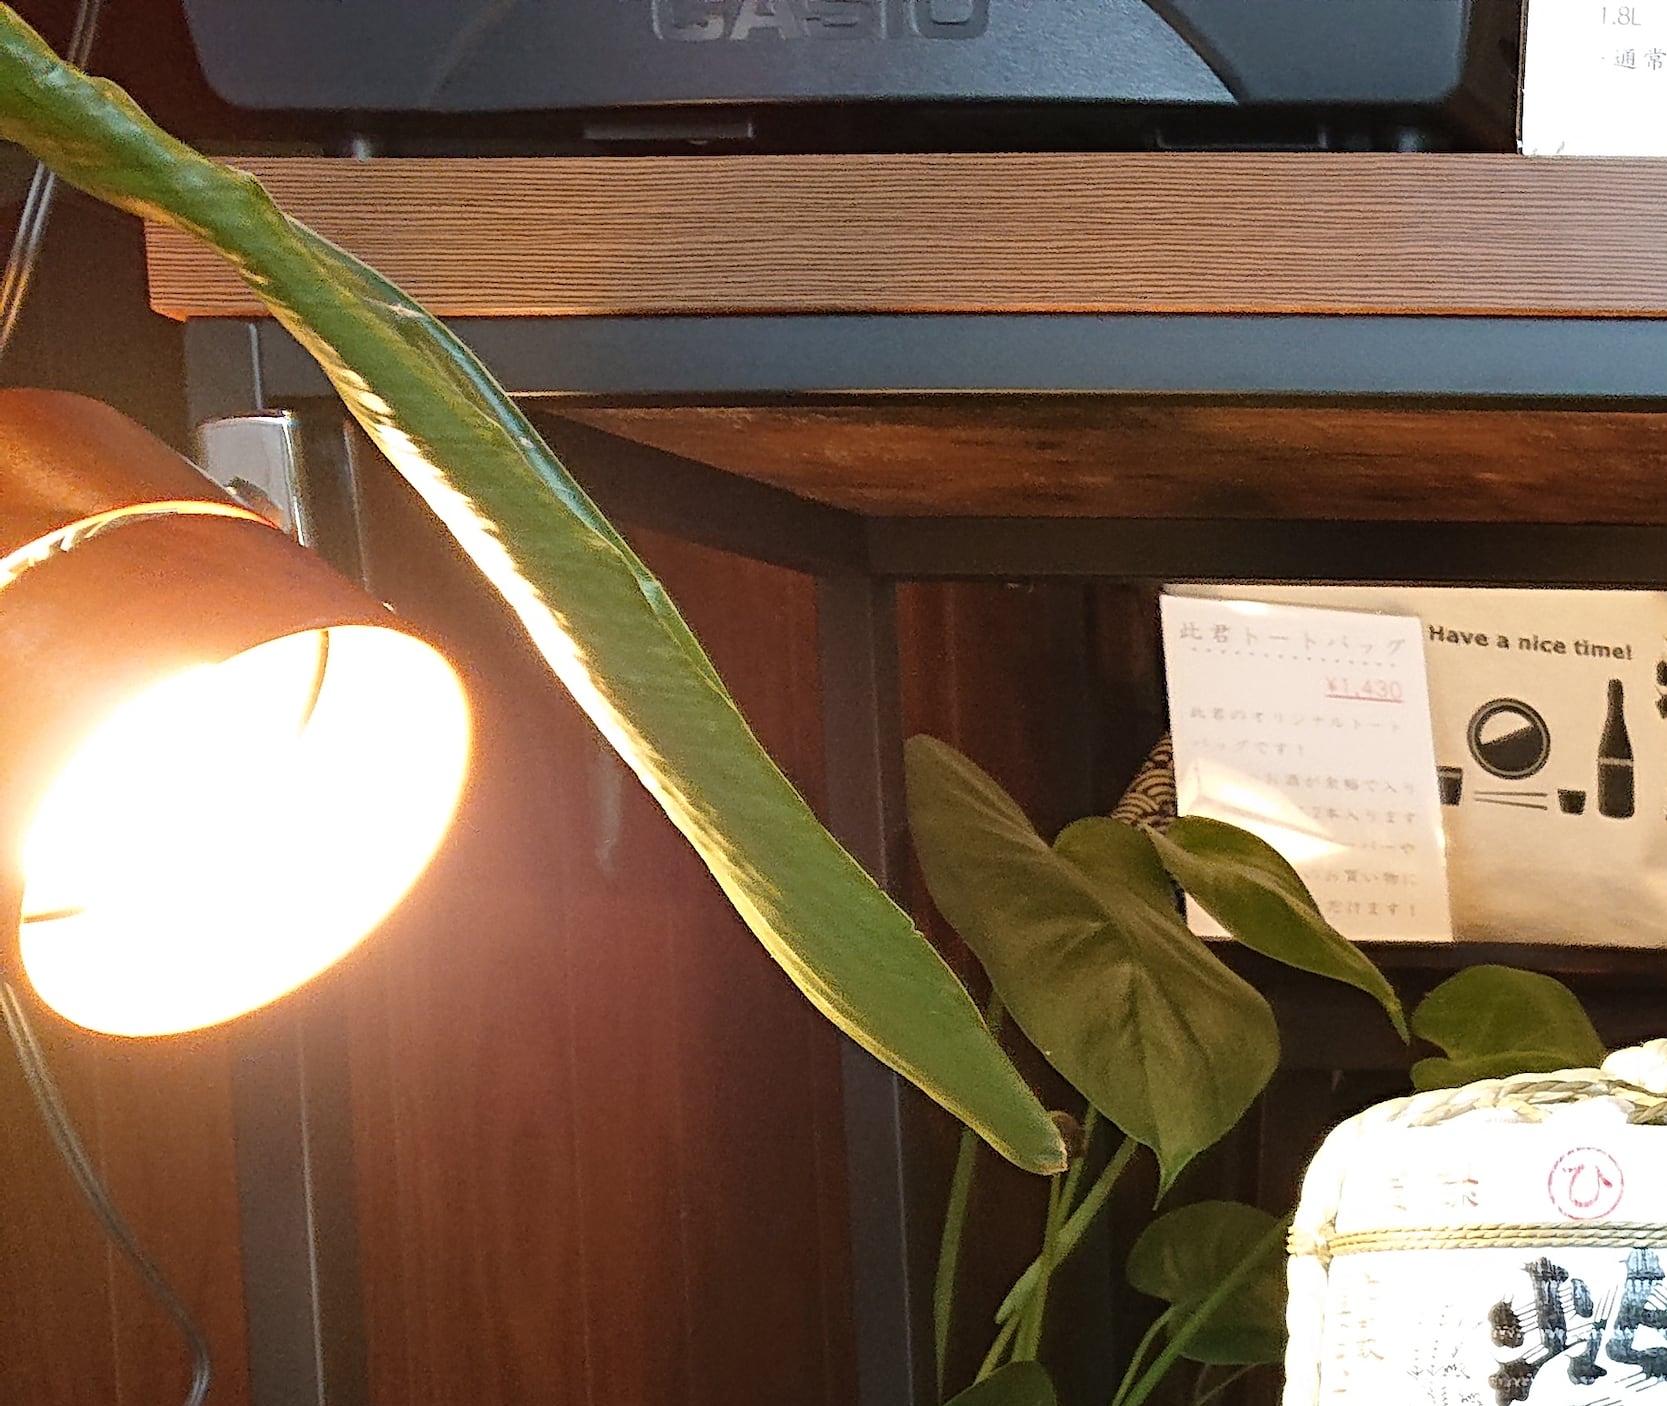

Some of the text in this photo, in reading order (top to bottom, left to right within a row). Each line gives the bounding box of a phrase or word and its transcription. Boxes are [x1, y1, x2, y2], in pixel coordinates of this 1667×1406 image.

[1602, 6, 1642, 25] 1.8L
[1428, 624, 1633, 660] Have a nice time!
[1326, 676, 1403, 699] ¥1,430
